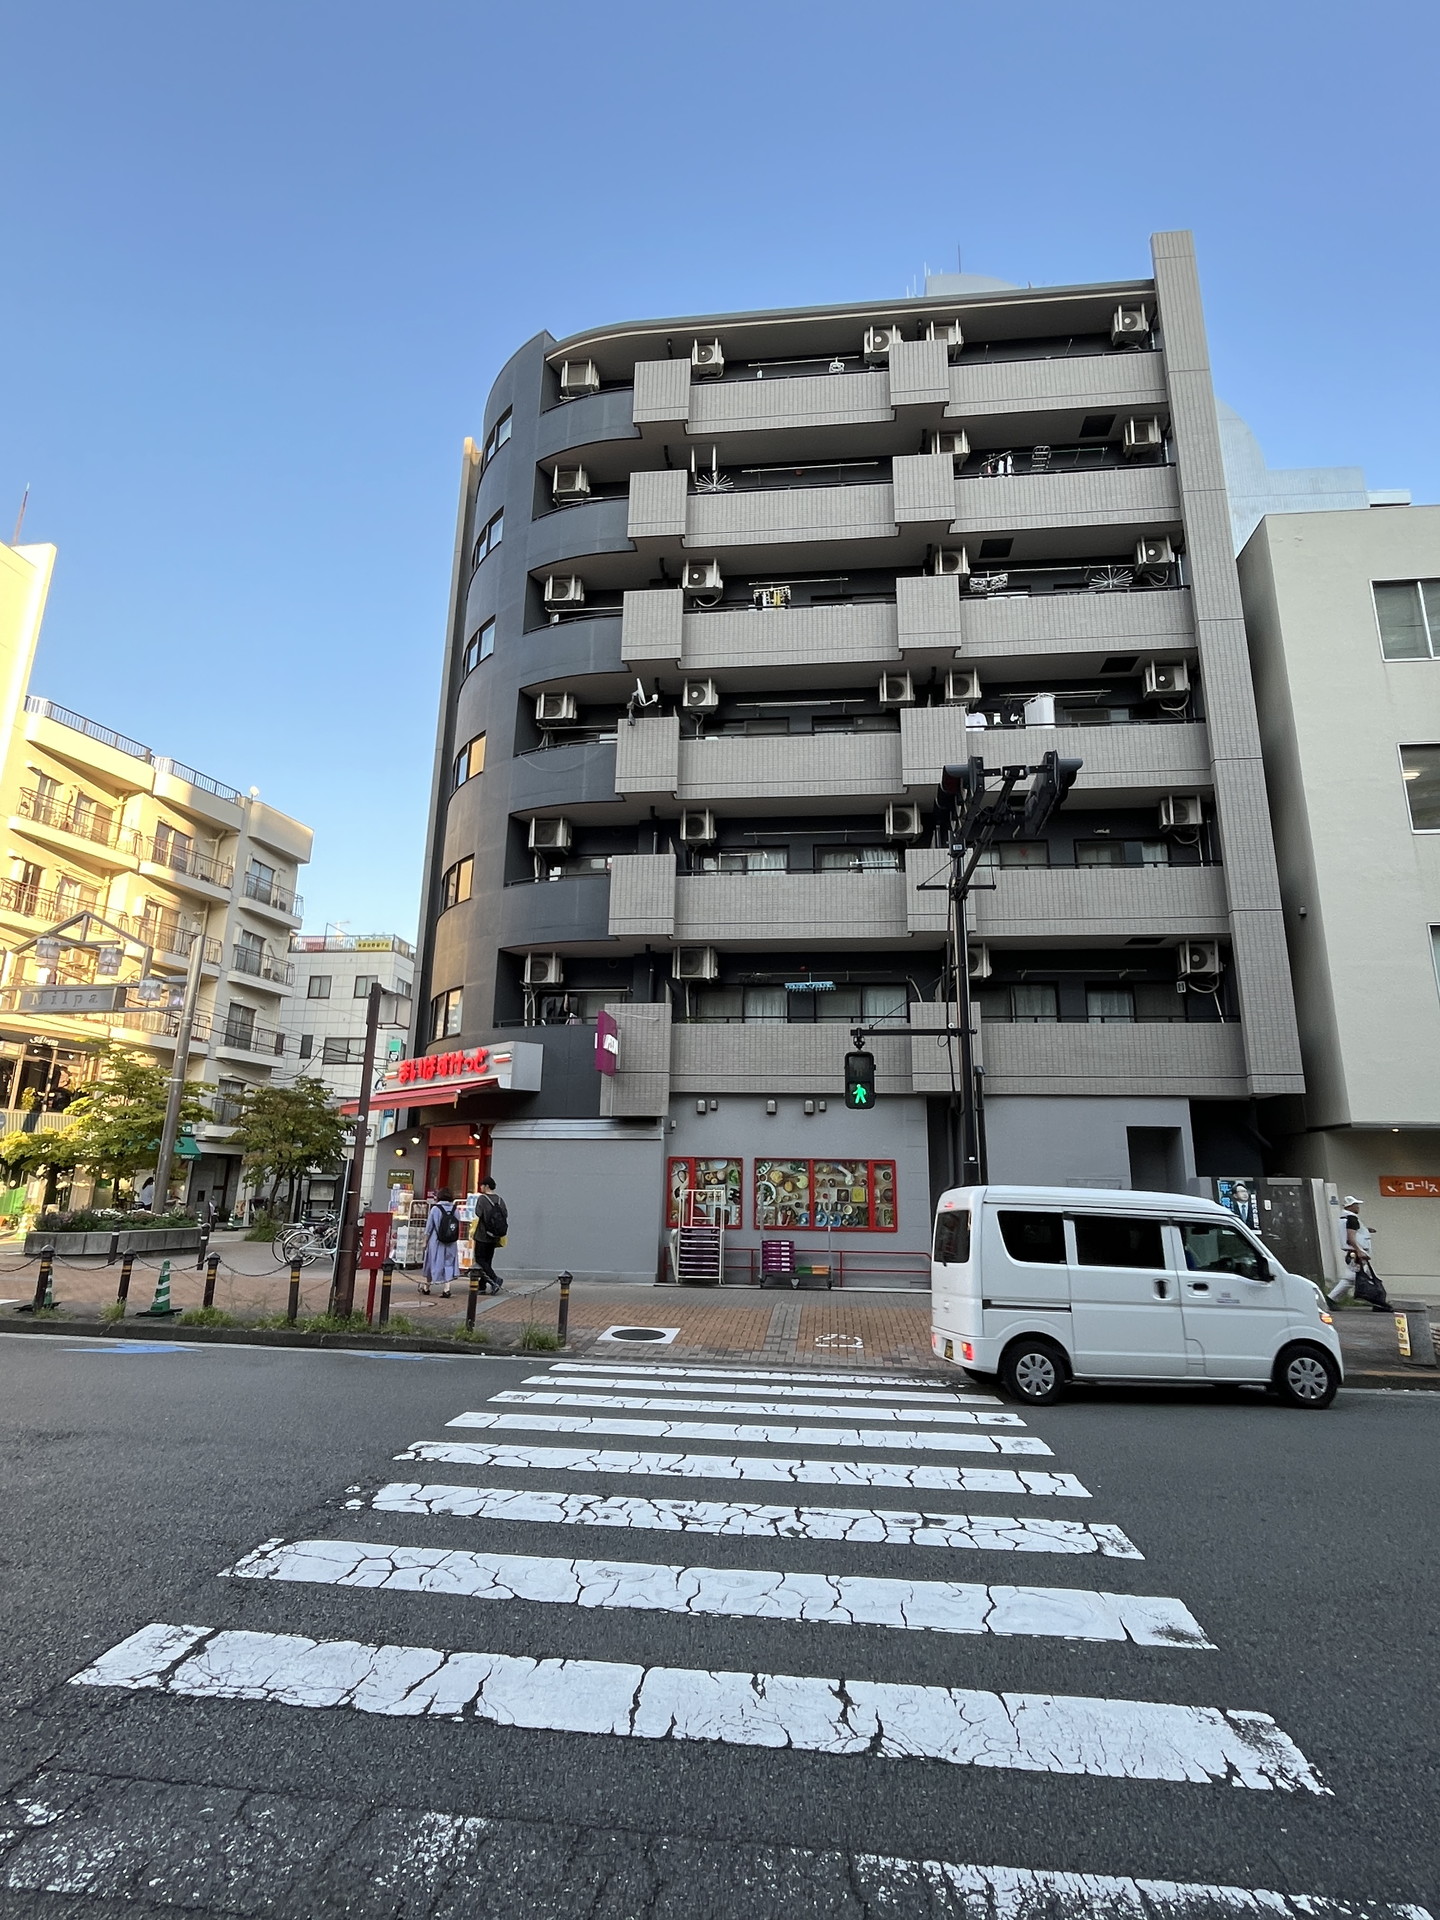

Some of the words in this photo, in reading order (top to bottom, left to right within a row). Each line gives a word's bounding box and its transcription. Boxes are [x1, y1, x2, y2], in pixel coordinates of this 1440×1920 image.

[29, 990, 98, 1008] Milpa
[397, 1046, 490, 1085] まいばすけっと
